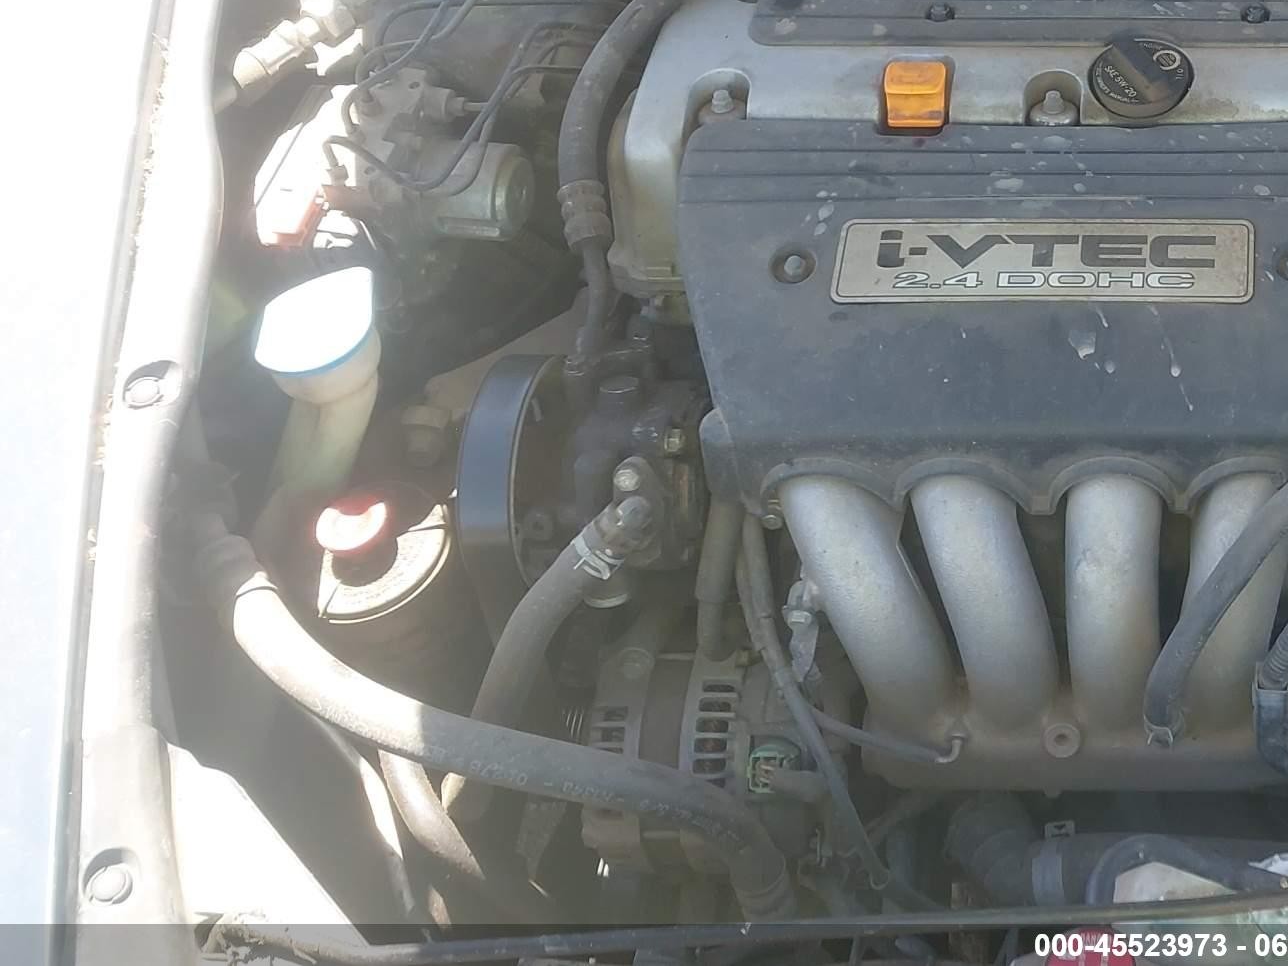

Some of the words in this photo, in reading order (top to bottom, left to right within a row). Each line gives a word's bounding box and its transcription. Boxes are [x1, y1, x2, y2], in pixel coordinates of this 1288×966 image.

[1104, 65, 1119, 79] SAE
[1114, 76, 1137, 98] 5W-20
[877, 229, 1216, 269] i-VTEC
[893, 272, 983, 289] 2.4
[996, 271, 1195, 289] DOHC
